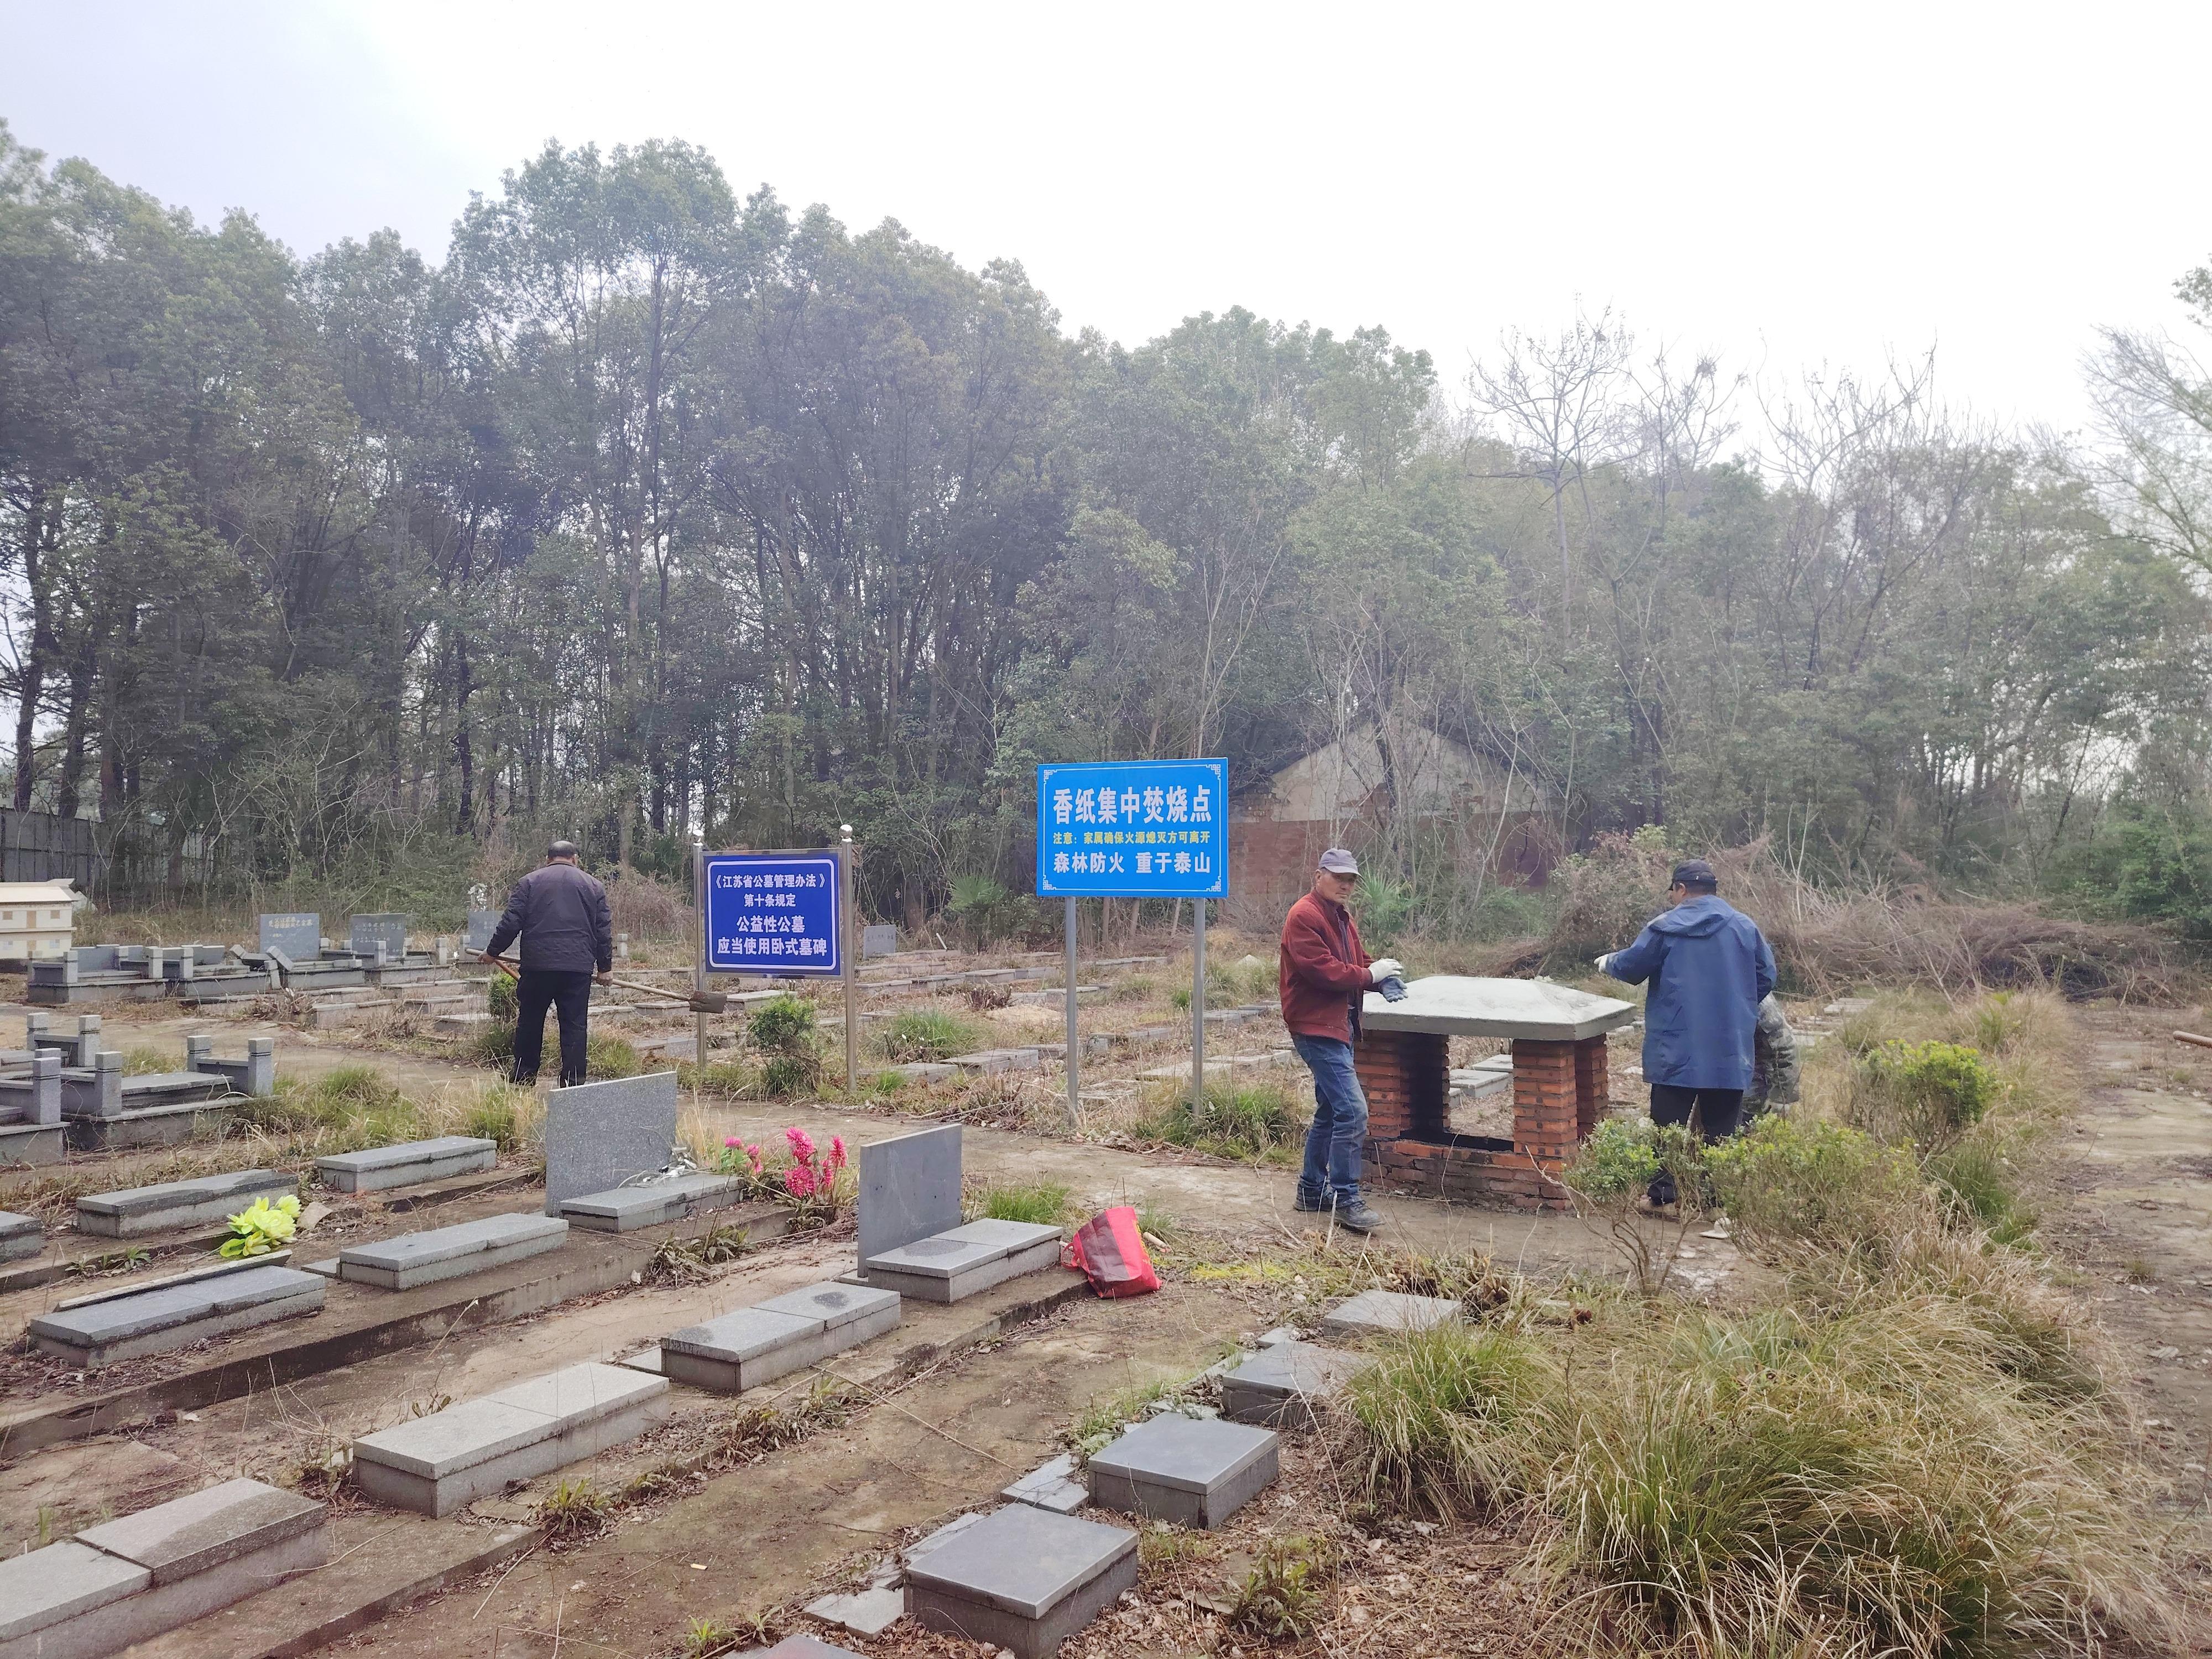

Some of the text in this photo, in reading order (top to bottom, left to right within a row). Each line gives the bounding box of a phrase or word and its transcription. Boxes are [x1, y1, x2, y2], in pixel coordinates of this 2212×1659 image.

[1053, 785, 1212, 824] 香纸集中焚烧点
[1053, 851, 1211, 874] 森林防火 重于泰山
[716, 874, 825, 888] 《江苏省公墓管理办法》
[744, 893, 796, 907] 第十条规定
[737, 915, 805, 933] 公益性公墓
[717, 937, 827, 956] 应当使用卧式墓碑
